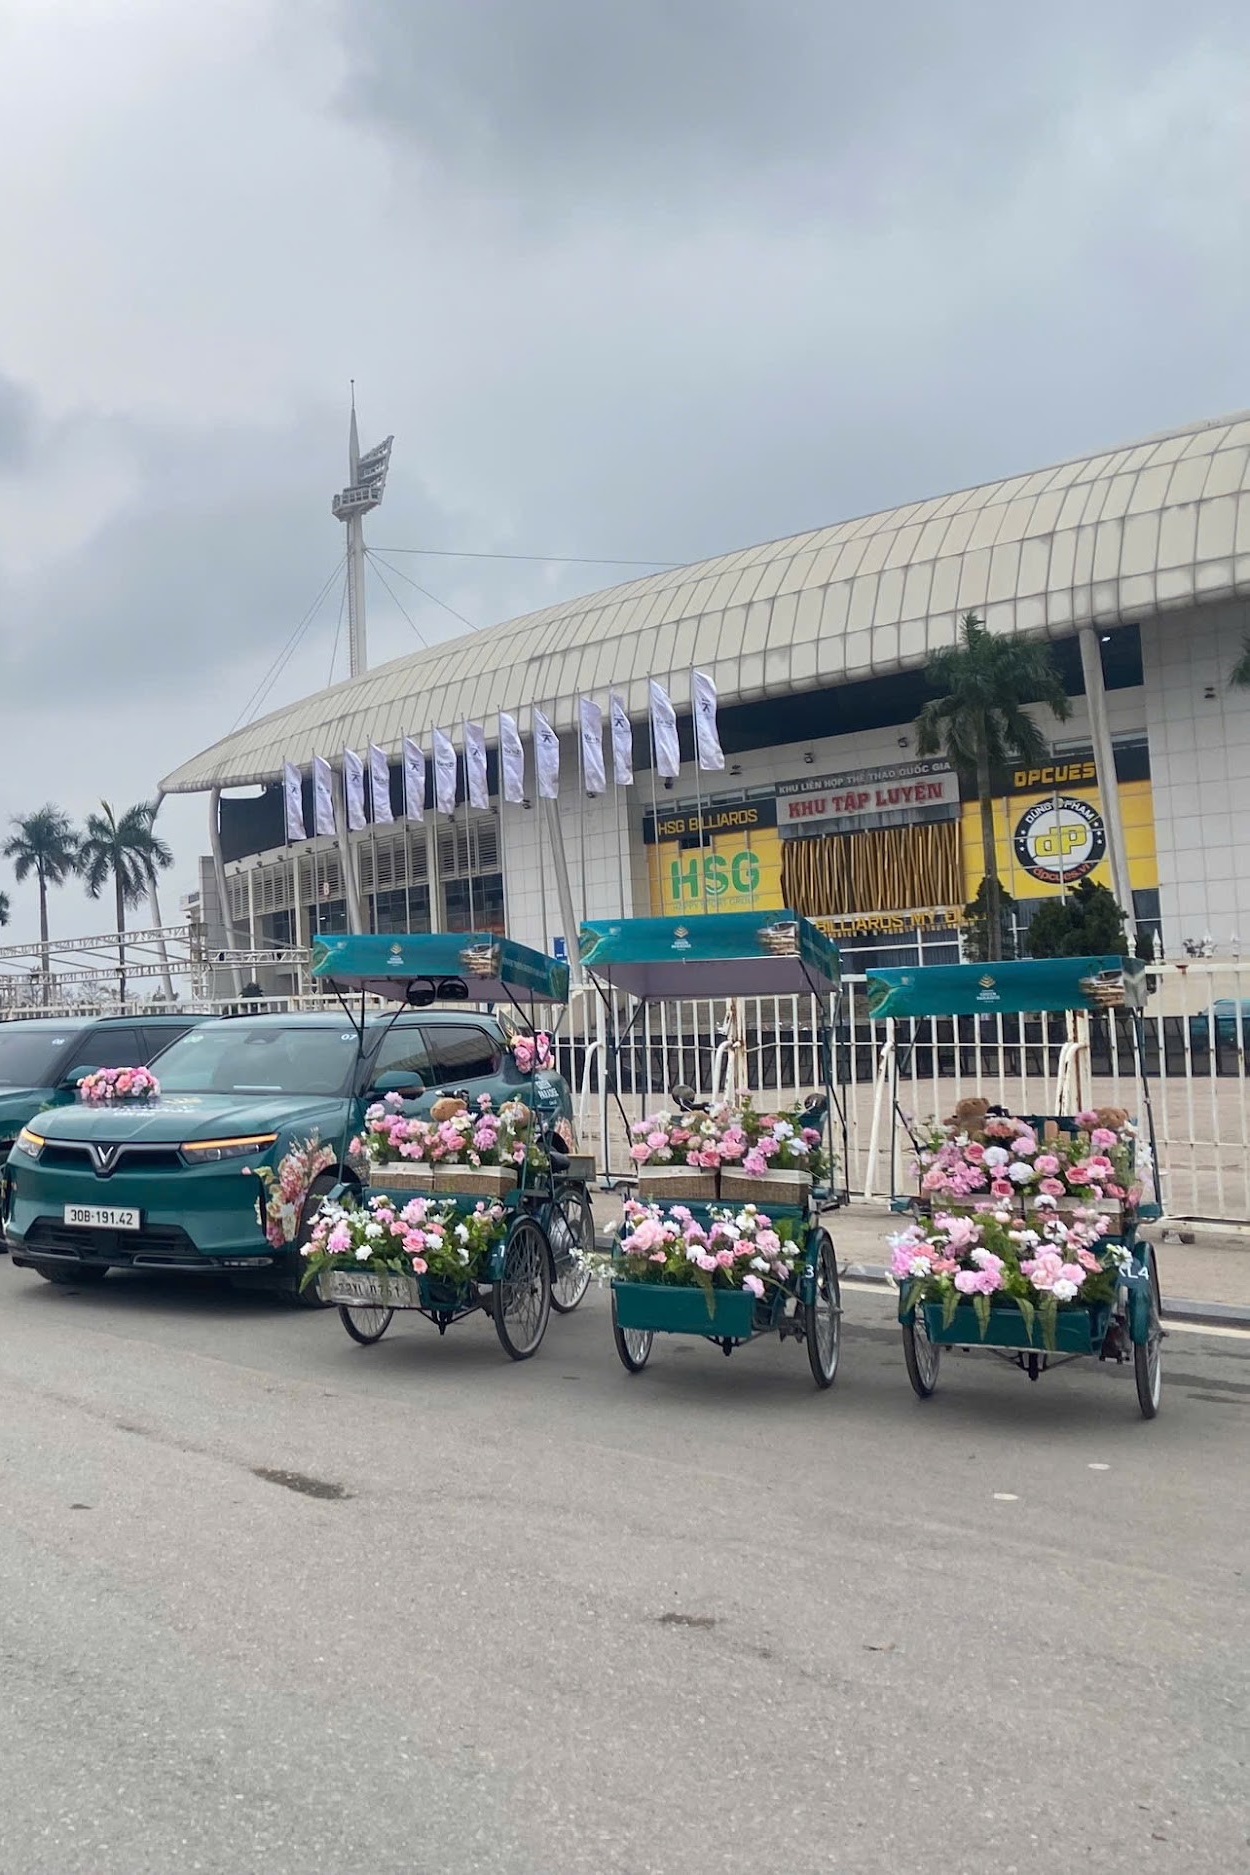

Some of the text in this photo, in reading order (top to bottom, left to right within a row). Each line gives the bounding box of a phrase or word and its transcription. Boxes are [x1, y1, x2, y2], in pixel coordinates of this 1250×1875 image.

[779, 784, 798, 794] KHU
[932, 762, 951, 771] GIA
[1014, 762, 1095, 788] DPCUES
[788, 782, 943, 818] KHU TẬP LUYỆN
[658, 808, 758, 836] HSG BLLIARDS
[671, 851, 760, 899] HSG
